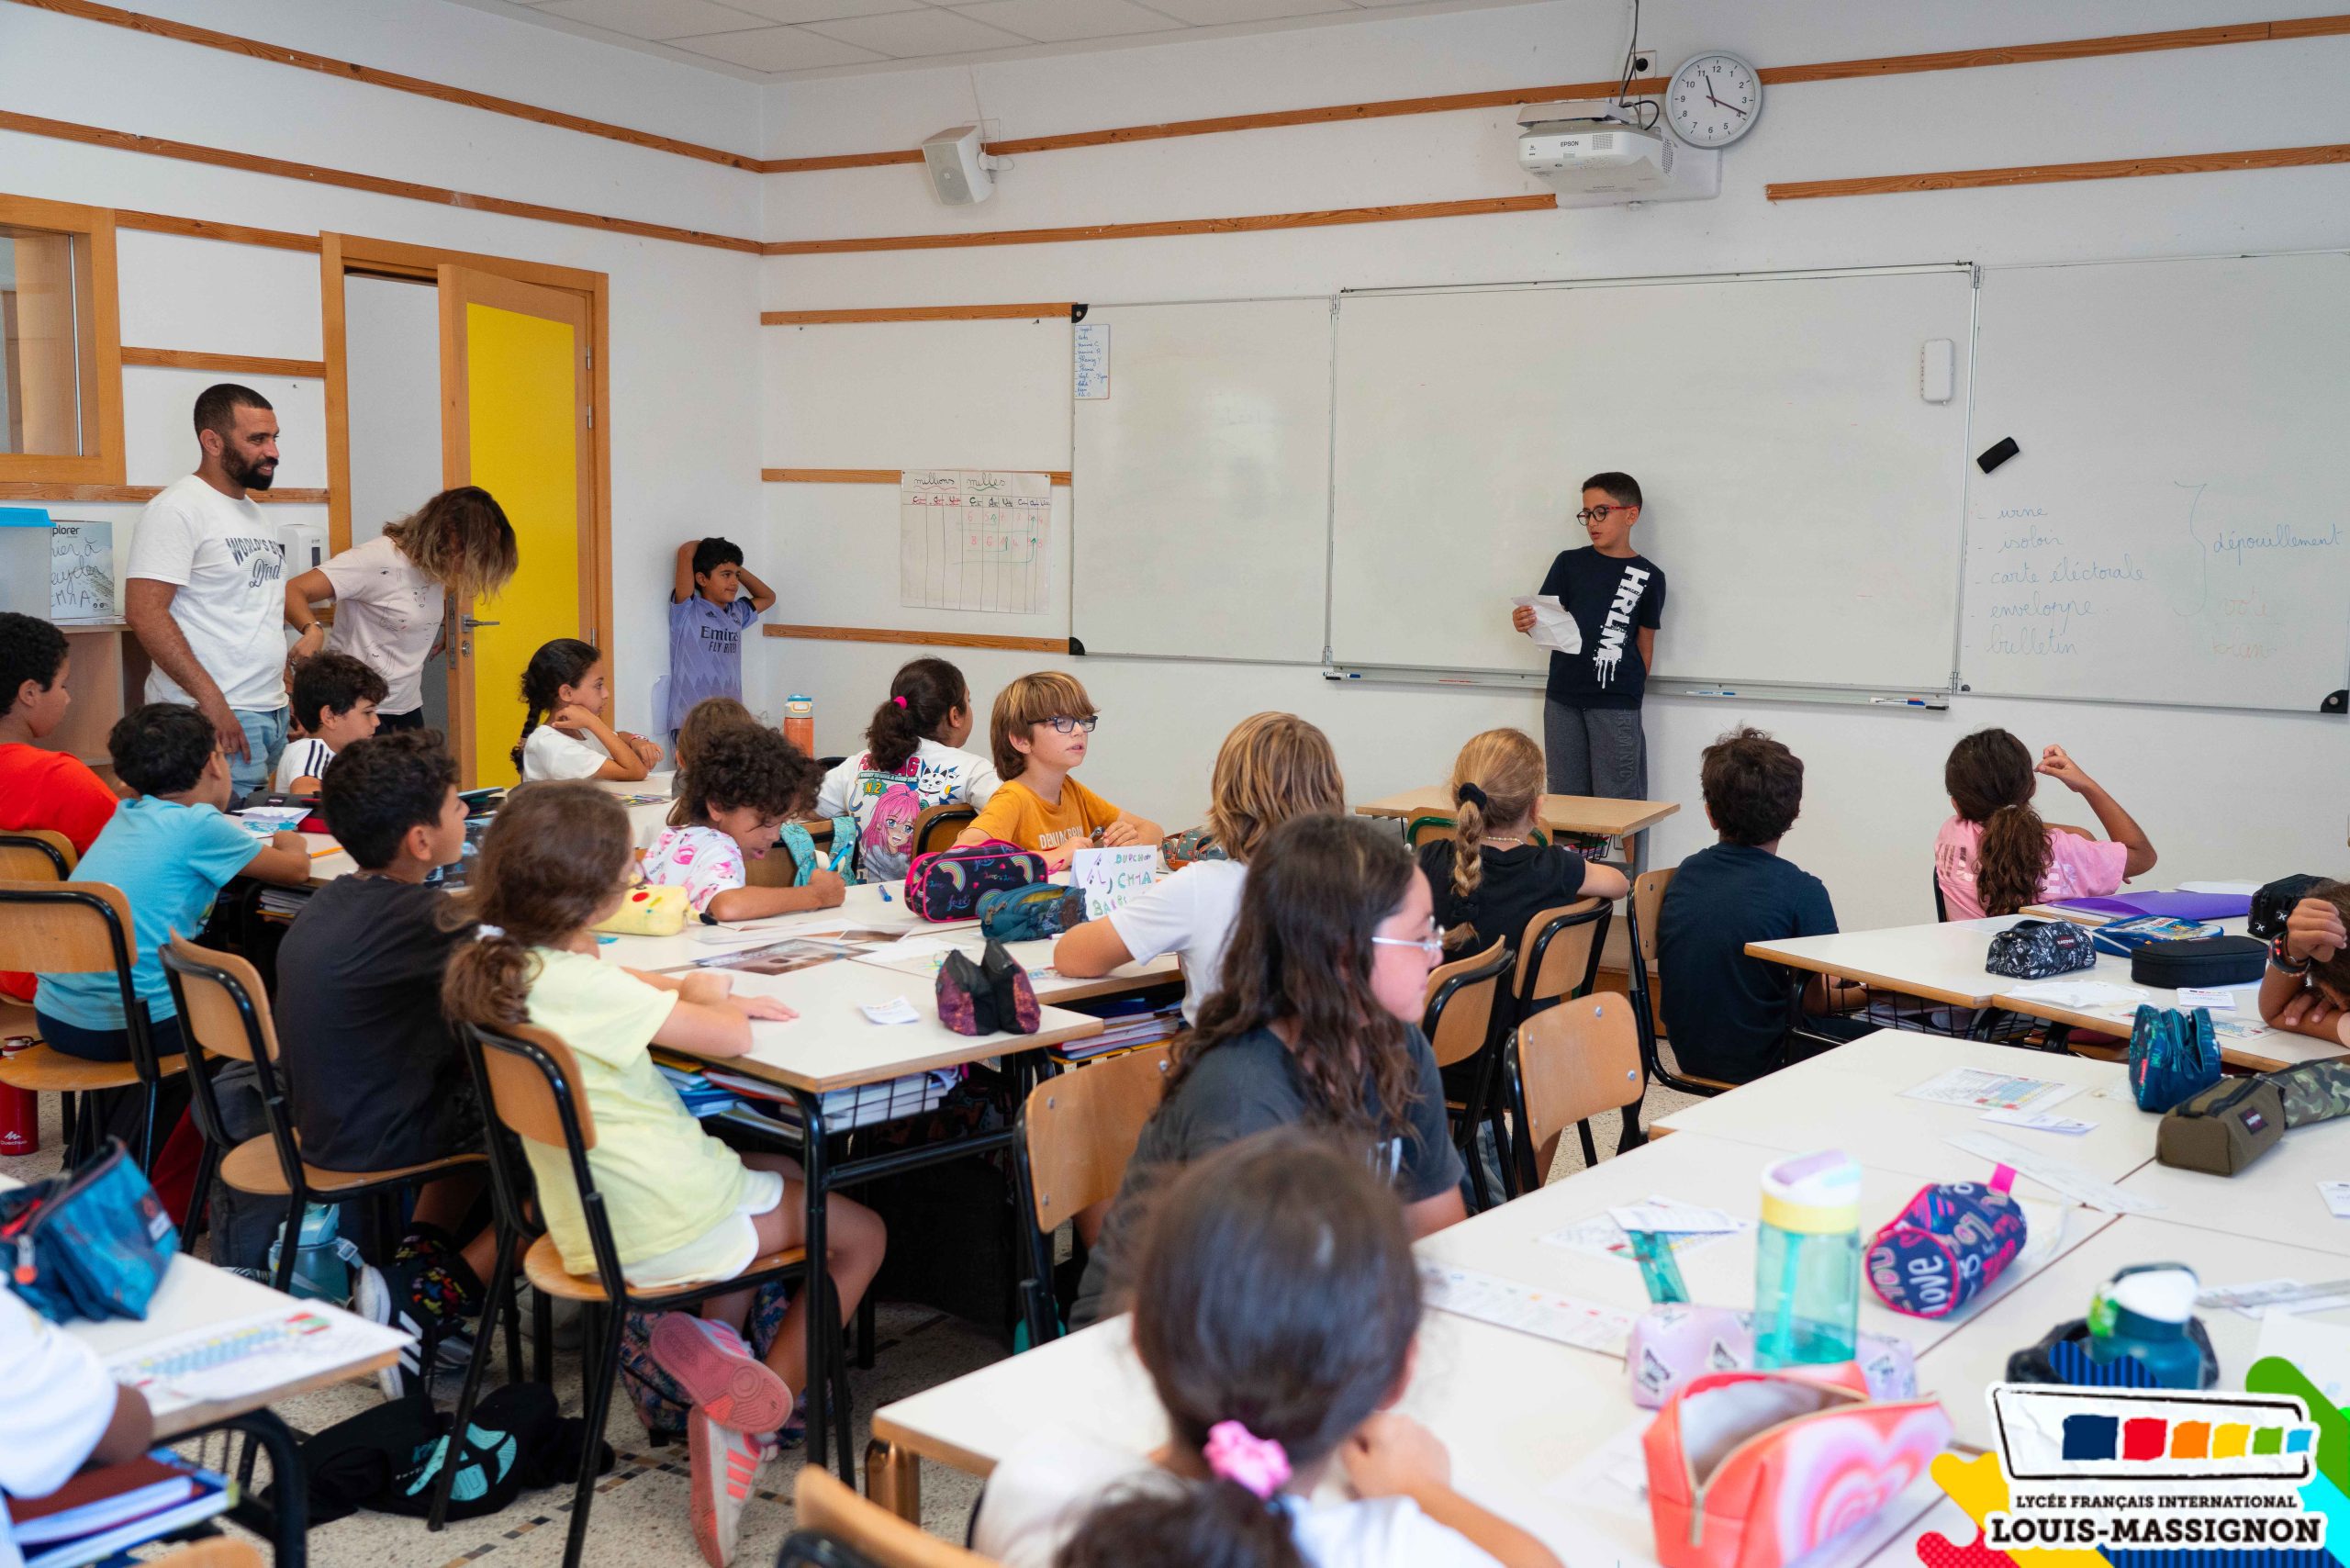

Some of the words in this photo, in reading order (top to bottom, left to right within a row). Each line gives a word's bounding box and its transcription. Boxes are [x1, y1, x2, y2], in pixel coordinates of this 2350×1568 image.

[1697, 69, 1707, 78] 11
[1712, 65, 1721, 73] 12
[1729, 70, 1734, 78] 1
[1685, 80, 1695, 88] 10
[1739, 81, 1744, 89] 2
[1692, 121, 1697, 129] 7
[1707, 126, 1713, 134] 6
[1723, 122, 1729, 130] 5
[1998, 507, 2048, 521] urne
[2212, 522, 2343, 566] dépouillement
[225, 537, 269, 566] WORLD'S
[249, 554, 283, 588] Dad
[1990, 561, 2040, 585] carte
[1990, 590, 2094, 635] enveloppe
[1986, 624, 2079, 656] bulletin
[709, 641, 722, 653] FLY
